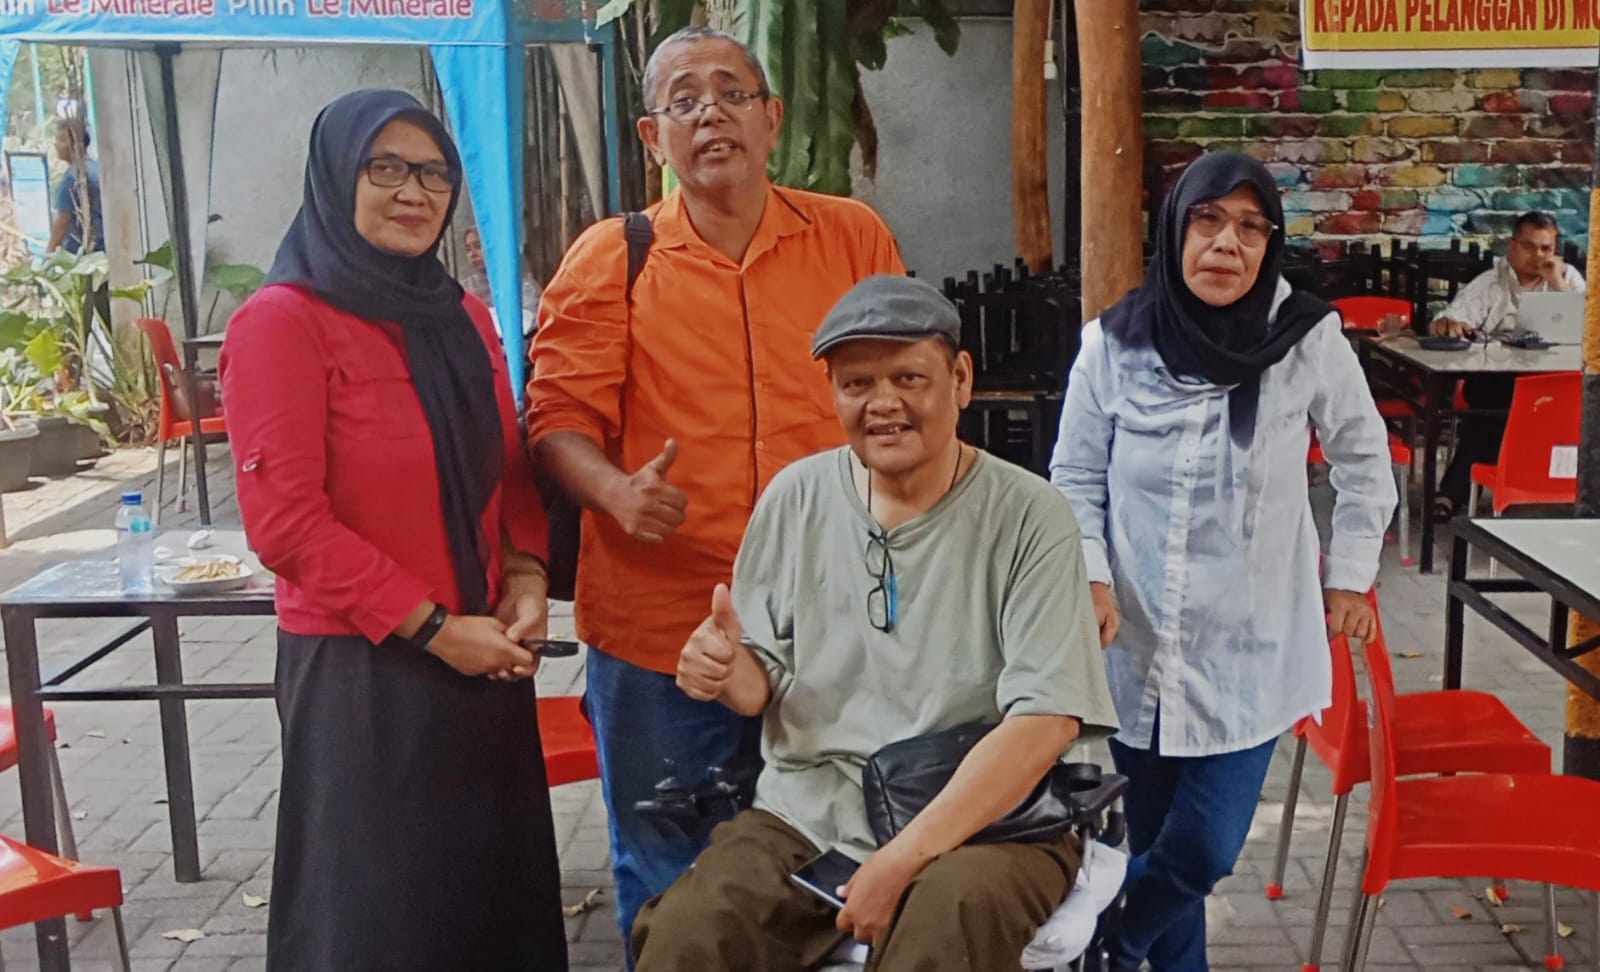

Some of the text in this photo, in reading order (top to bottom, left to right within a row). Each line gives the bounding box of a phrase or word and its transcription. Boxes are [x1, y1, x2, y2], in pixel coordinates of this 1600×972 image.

[47, 0, 80, 15] Le
[89, 0, 213, 16] Minerale
[307, 0, 341, 17] Le
[348, 0, 473, 18] Minerale
[1313, 0, 1399, 33] KEPADA
[1405, 0, 1537, 33] PELANGGAN
[1544, 0, 1565, 31] DI
